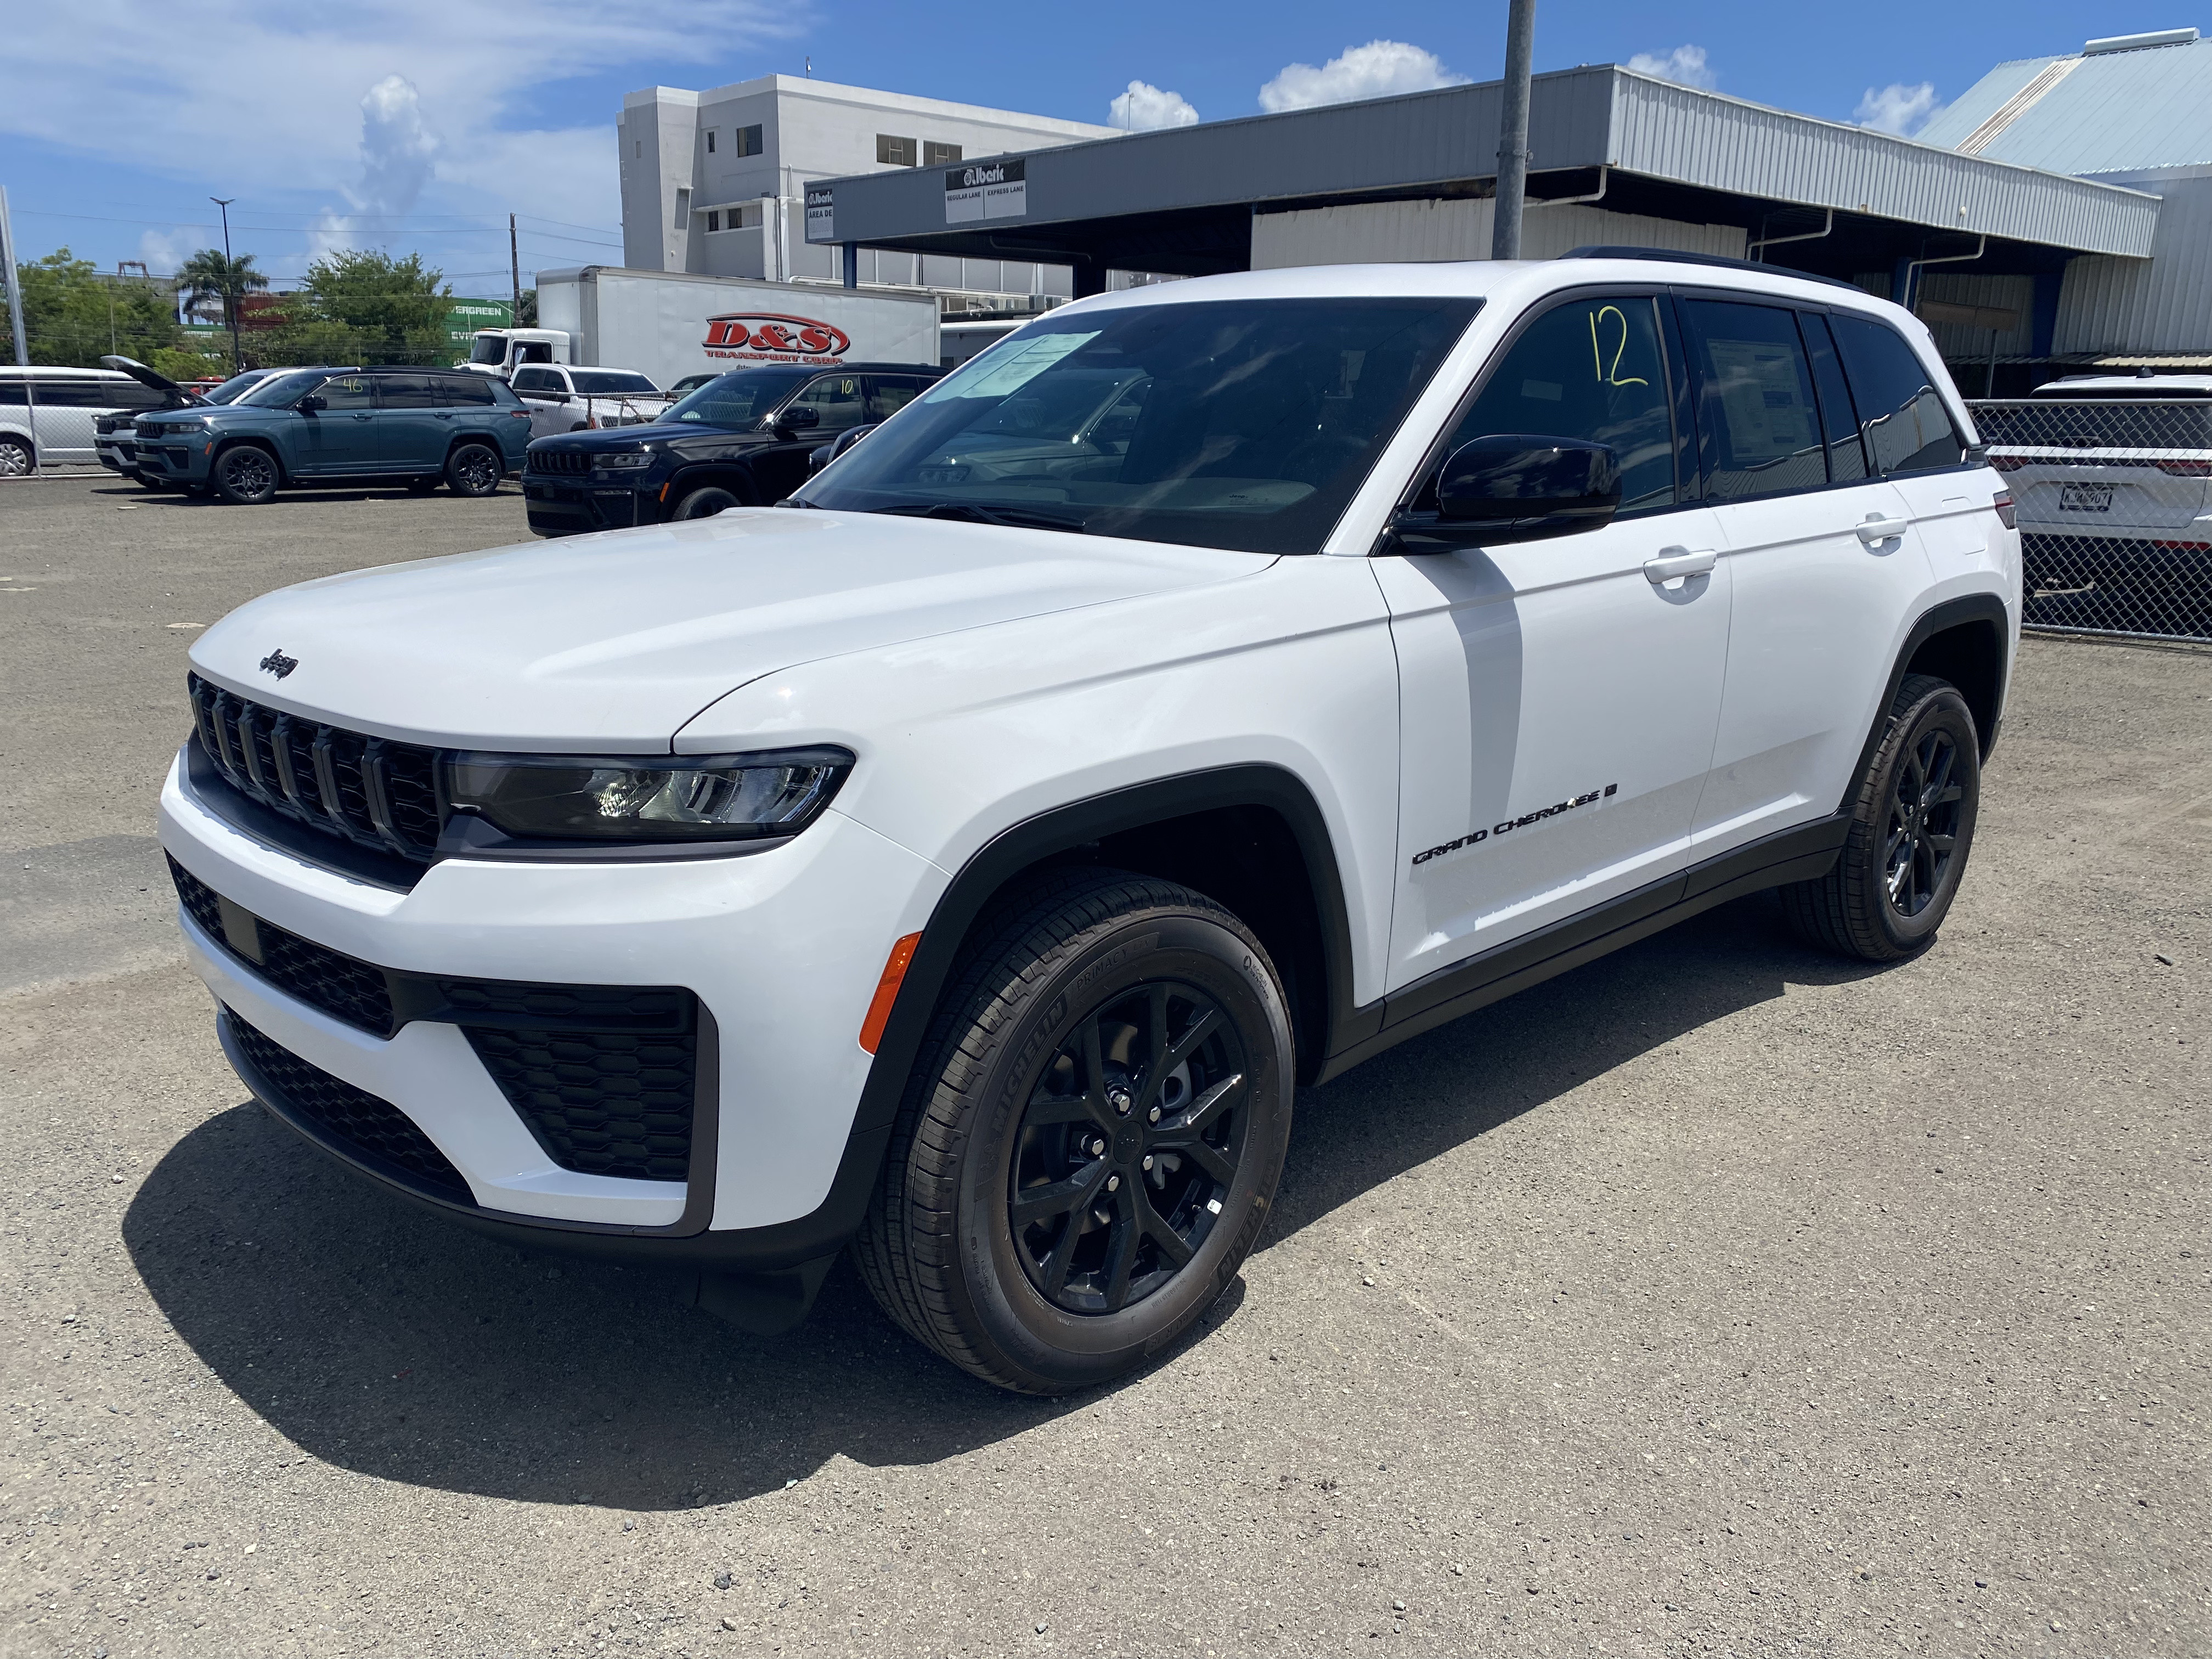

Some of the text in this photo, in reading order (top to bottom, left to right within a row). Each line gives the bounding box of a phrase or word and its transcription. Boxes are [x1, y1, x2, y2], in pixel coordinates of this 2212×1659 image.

[947, 193, 968, 201] REGULAR
[988, 187, 1009, 196] EXPRESS
[825, 209, 833, 217] DE
[702, 319, 833, 354] D&S
[1589, 305, 1649, 386] 12
[704, 349, 843, 364] TRANSPORT CORP
[343, 379, 363, 392] 46
[842, 380, 853, 394] 10
[259, 648, 299, 681] Jeep
[1412, 829, 1488, 865] GRAND
[1076, 949, 1128, 992] PRIMACY
[991, 1002, 1063, 1133] MICHELIN
